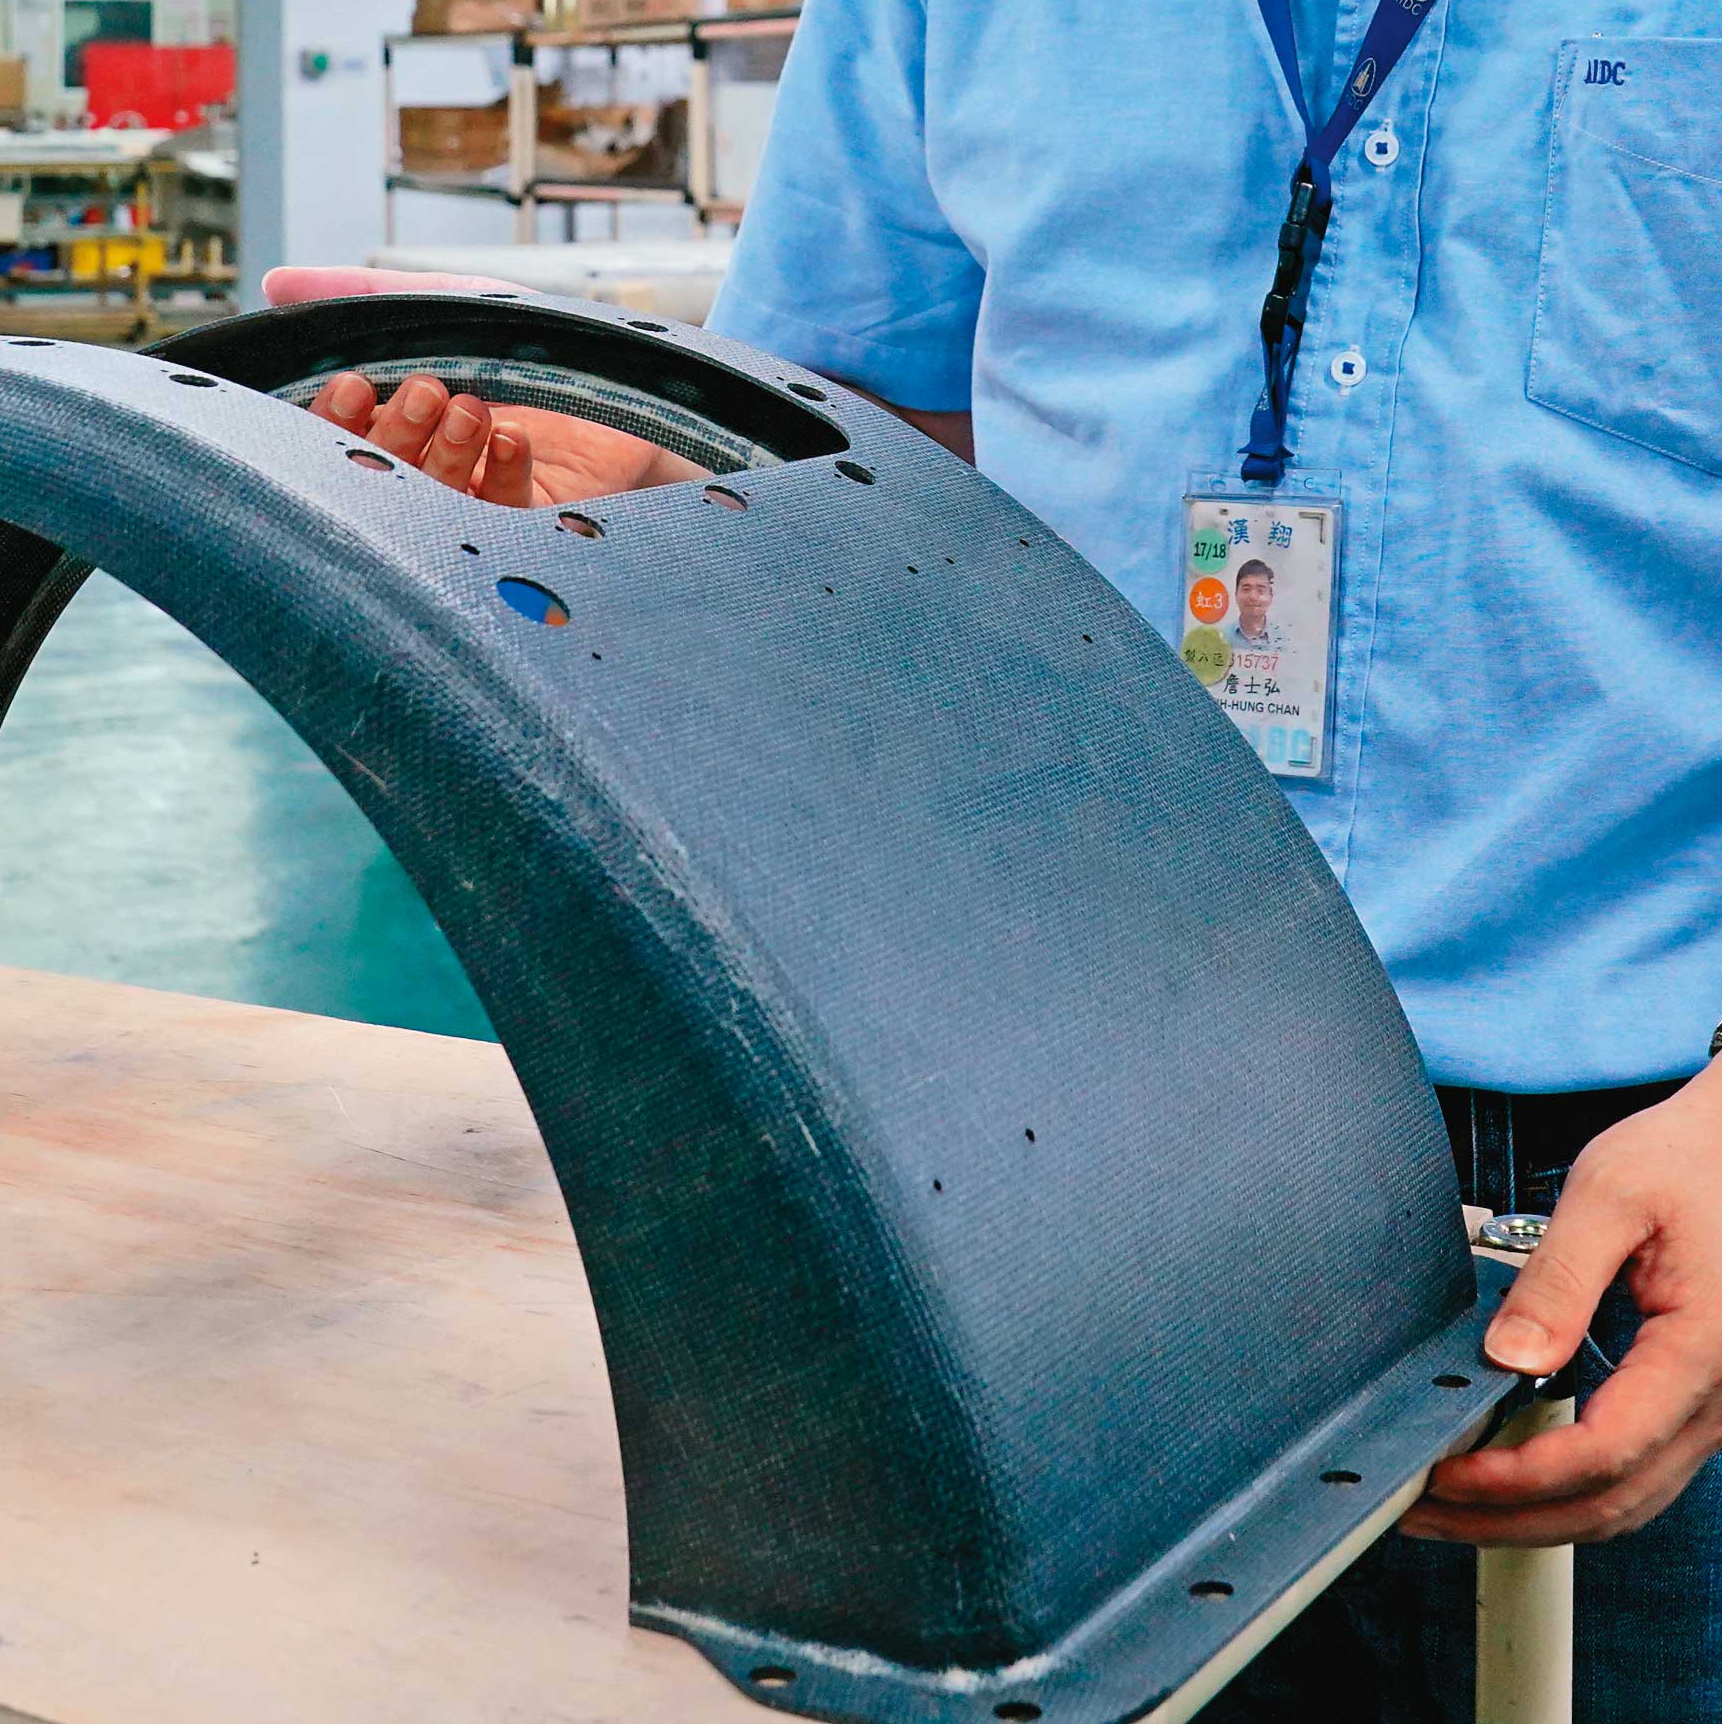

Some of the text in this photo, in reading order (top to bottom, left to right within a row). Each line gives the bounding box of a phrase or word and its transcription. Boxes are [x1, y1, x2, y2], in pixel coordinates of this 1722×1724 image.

[1226, 518, 1293, 548] 漢翔
[1193, 542, 1227, 561] 17/18
[1223, 673, 1280, 696] 詹士弘
[1267, 702, 1301, 716] CHAN
